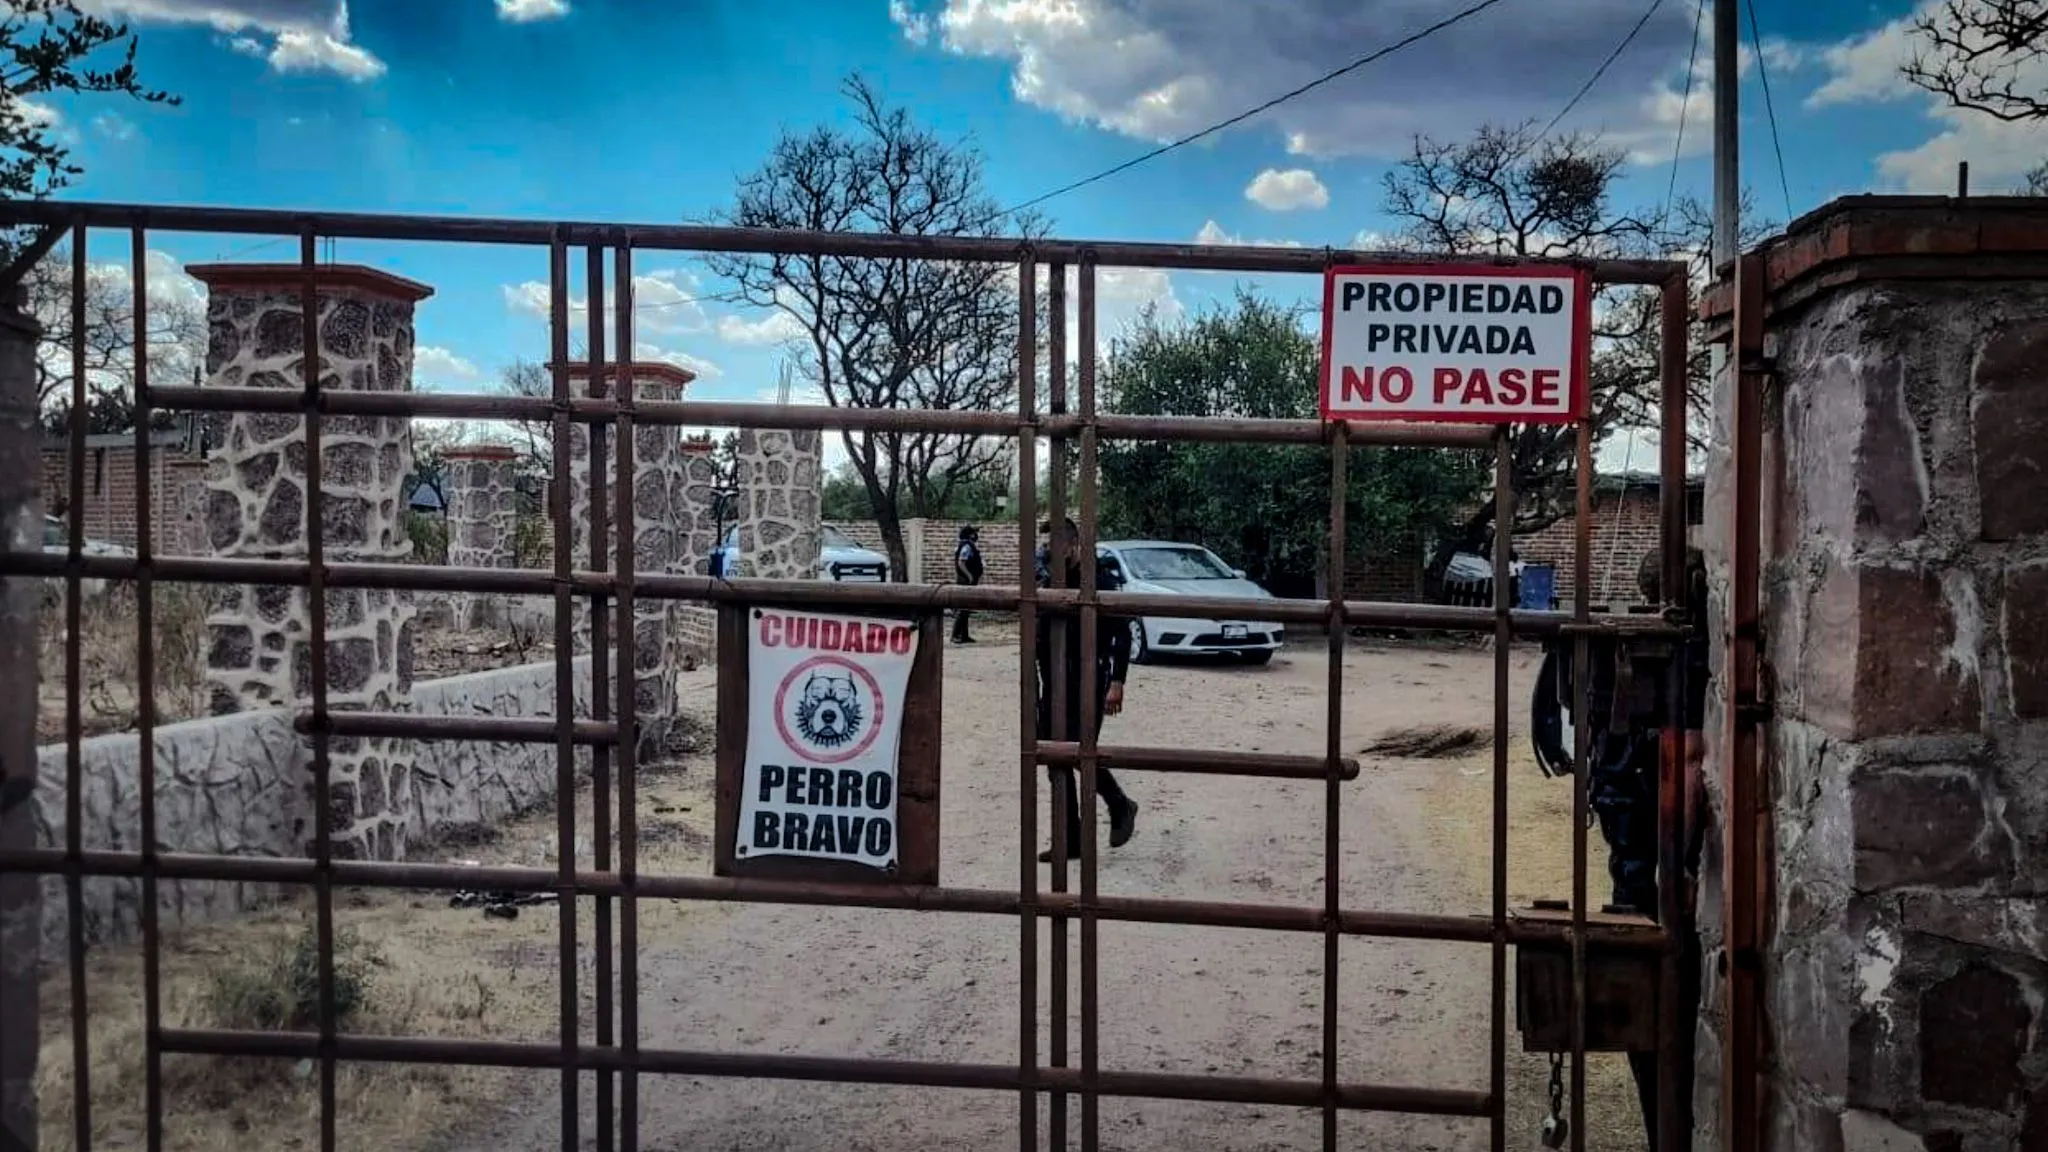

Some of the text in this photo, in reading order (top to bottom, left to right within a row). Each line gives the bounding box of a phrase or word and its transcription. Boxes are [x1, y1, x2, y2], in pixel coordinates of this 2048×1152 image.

[1343, 282, 1563, 314] PROPIEDAD
[1367, 324, 1536, 355] PRIVADA
[1341, 365, 1560, 405] NO PASE
[760, 614, 912, 655] CUIDADO
[759, 764, 891, 810] PERRO
[753, 811, 892, 856] BRAVO
